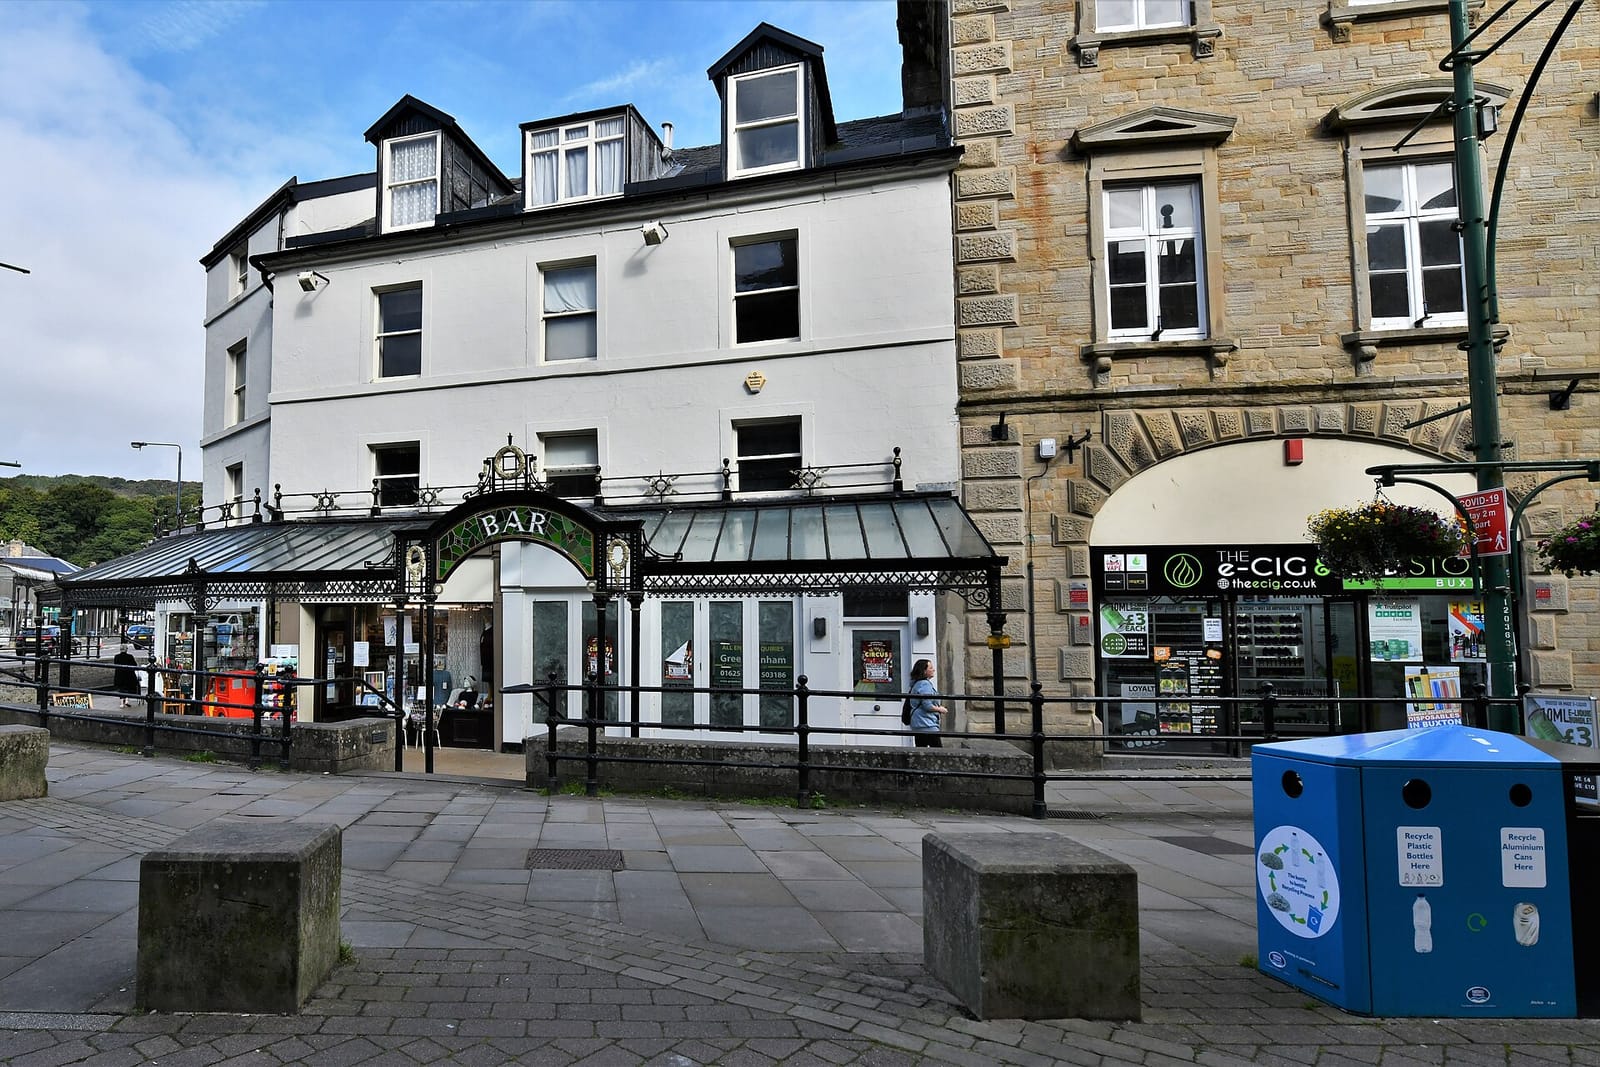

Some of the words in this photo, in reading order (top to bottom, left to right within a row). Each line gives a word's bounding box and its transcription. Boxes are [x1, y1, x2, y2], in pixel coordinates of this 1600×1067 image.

[1470, 512, 1480, 520] tay
[481, 511, 546, 537] BAR
[1473, 520, 1491, 529] part
[1216, 550, 1250, 562] THE
[1218, 557, 1306, 577] e-CIG
[1232, 578, 1317, 590] theecig.co.uk
[1124, 612, 1146, 625] £3
[761, 671, 787, 679] 503186
[1408, 712, 1461, 722] DISPOSABLES
[1543, 708, 1568, 722] 10ML
[1410, 721, 1420, 729] IN
[1422, 718, 1462, 728] BUXTON
[1562, 726, 1592, 747] £3
[1404, 832, 1433, 841] Recycle
[1508, 833, 1537, 842] Recycle
[1407, 842, 1432, 850] Plastic
[1502, 843, 1544, 851] Aluminium
[1406, 852, 1433, 860] Bottles
[1514, 853, 1533, 861] Cans
[1411, 862, 1430, 870] Here
[1514, 863, 1533, 871] Here
